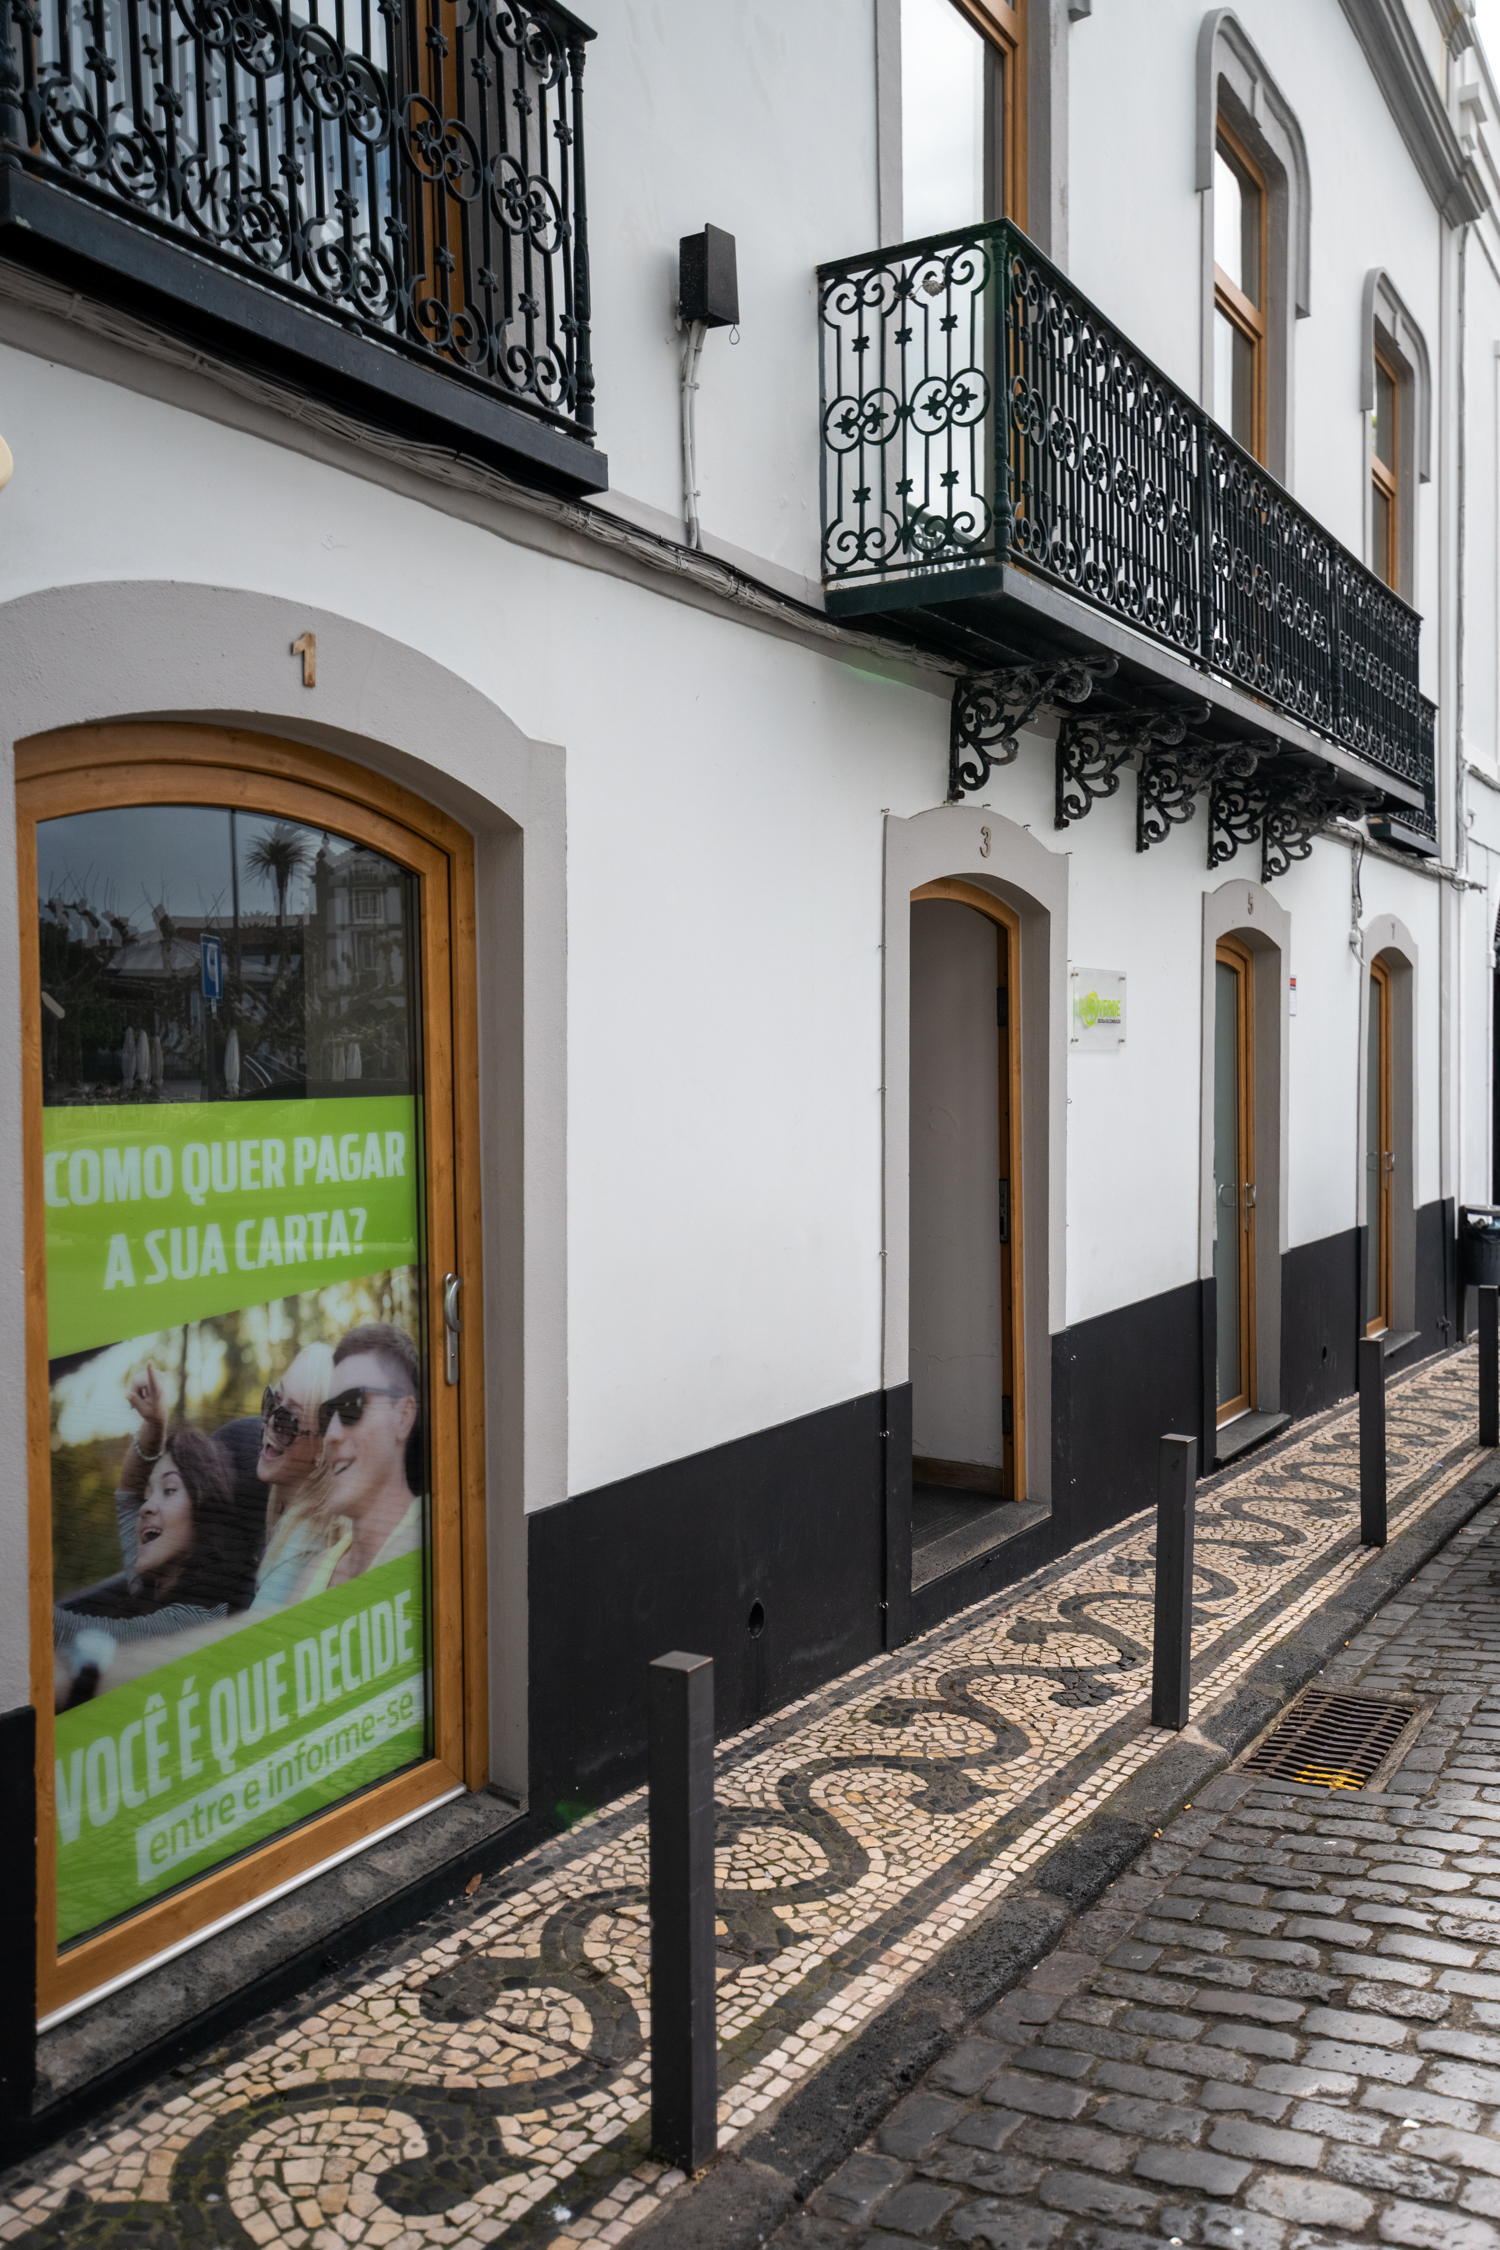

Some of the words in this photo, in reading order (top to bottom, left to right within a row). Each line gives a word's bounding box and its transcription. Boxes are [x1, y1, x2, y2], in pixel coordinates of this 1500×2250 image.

[291, 632, 316, 687] 1
[980, 826, 991, 858] 3
[1247, 892, 1254, 915] 5
[43, 1145, 173, 1208] COMO
[182, 1138, 286, 1206] QUER
[295, 1131, 406, 1186] PAGAR
[103, 1233, 136, 1291] A
[144, 1223, 228, 1285] SUA
[235, 1207, 368, 1271] CARTA?
[55, 1692, 171, 1846] VOCÊ
[177, 1675, 204, 1781] É
[209, 1651, 289, 1774] QUE
[294, 1589, 415, 1719] DECIDE
[149, 1797, 236, 1866] entre
[243, 1780, 260, 1811] e
[267, 1692, 414, 1794] informe-se
